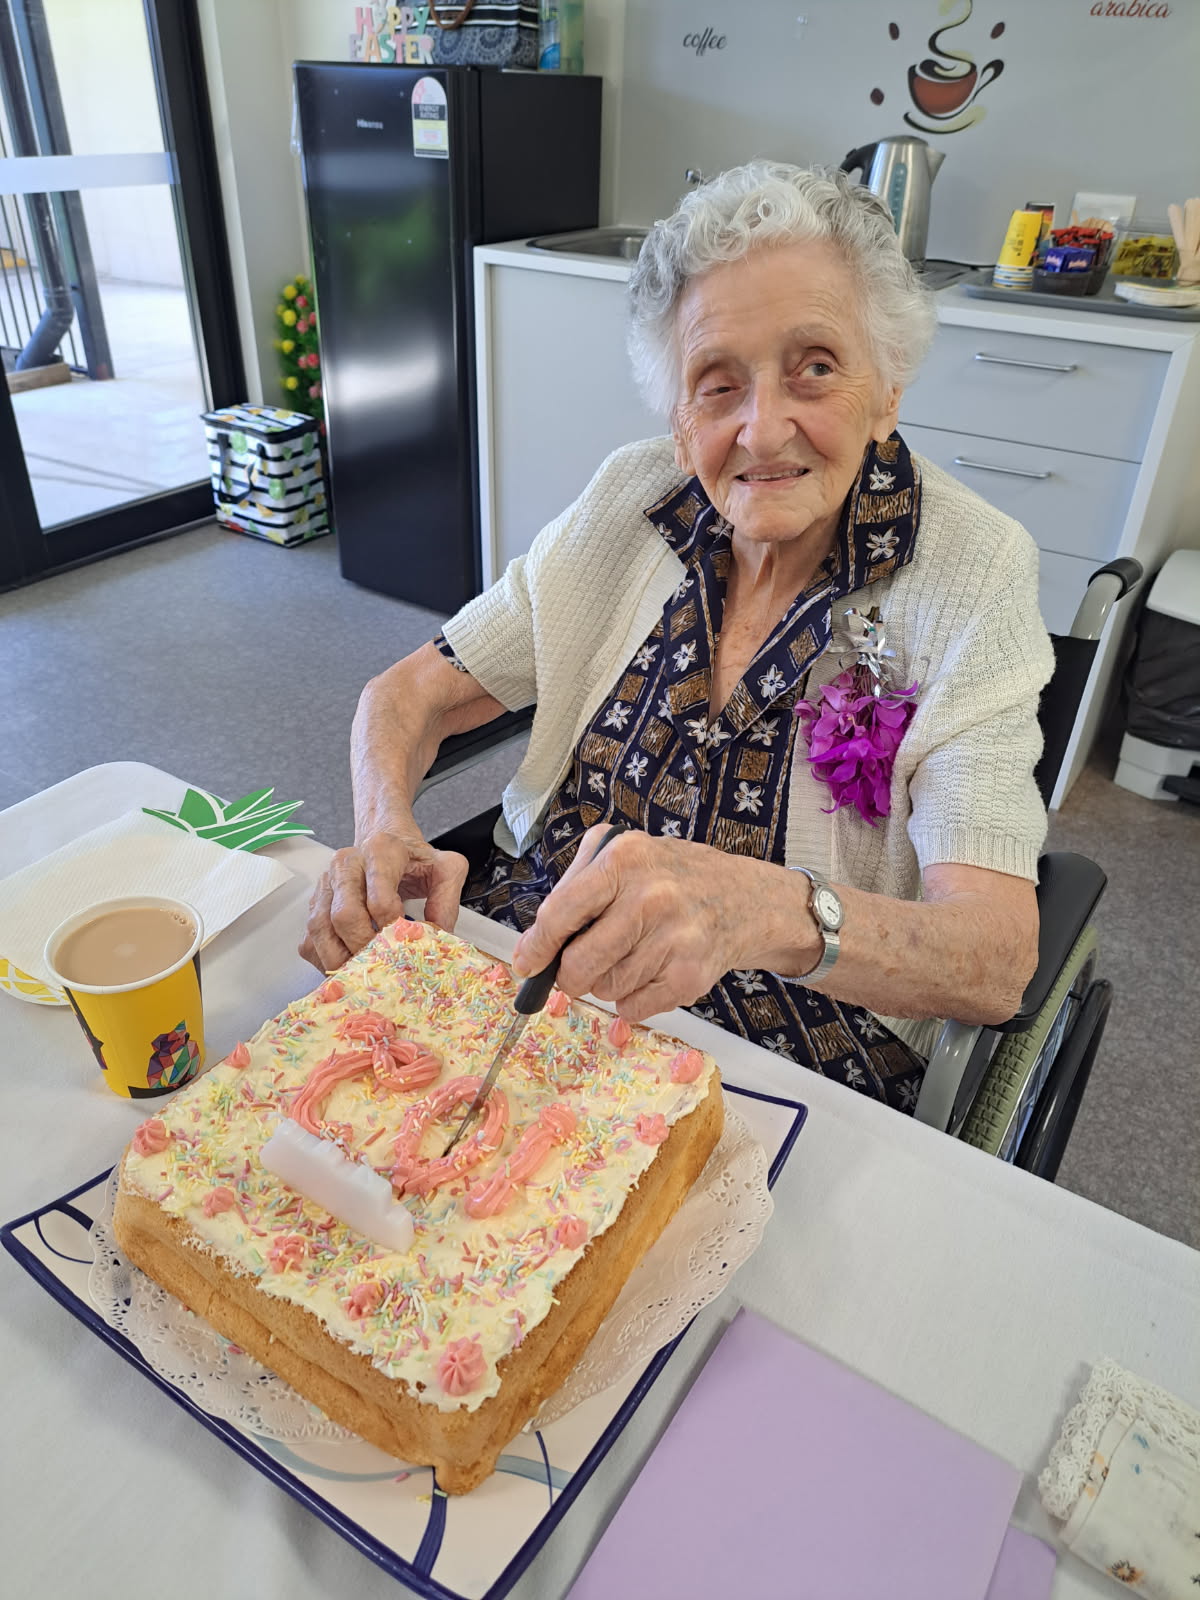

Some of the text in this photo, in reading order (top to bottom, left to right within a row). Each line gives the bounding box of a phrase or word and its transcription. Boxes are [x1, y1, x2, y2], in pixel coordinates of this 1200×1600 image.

[355, 6, 430, 35] HPPY
[1090, 0, 1171, 18] arabica
[349, 33, 434, 64] EASTER
[682, 26, 727, 56] coffee
